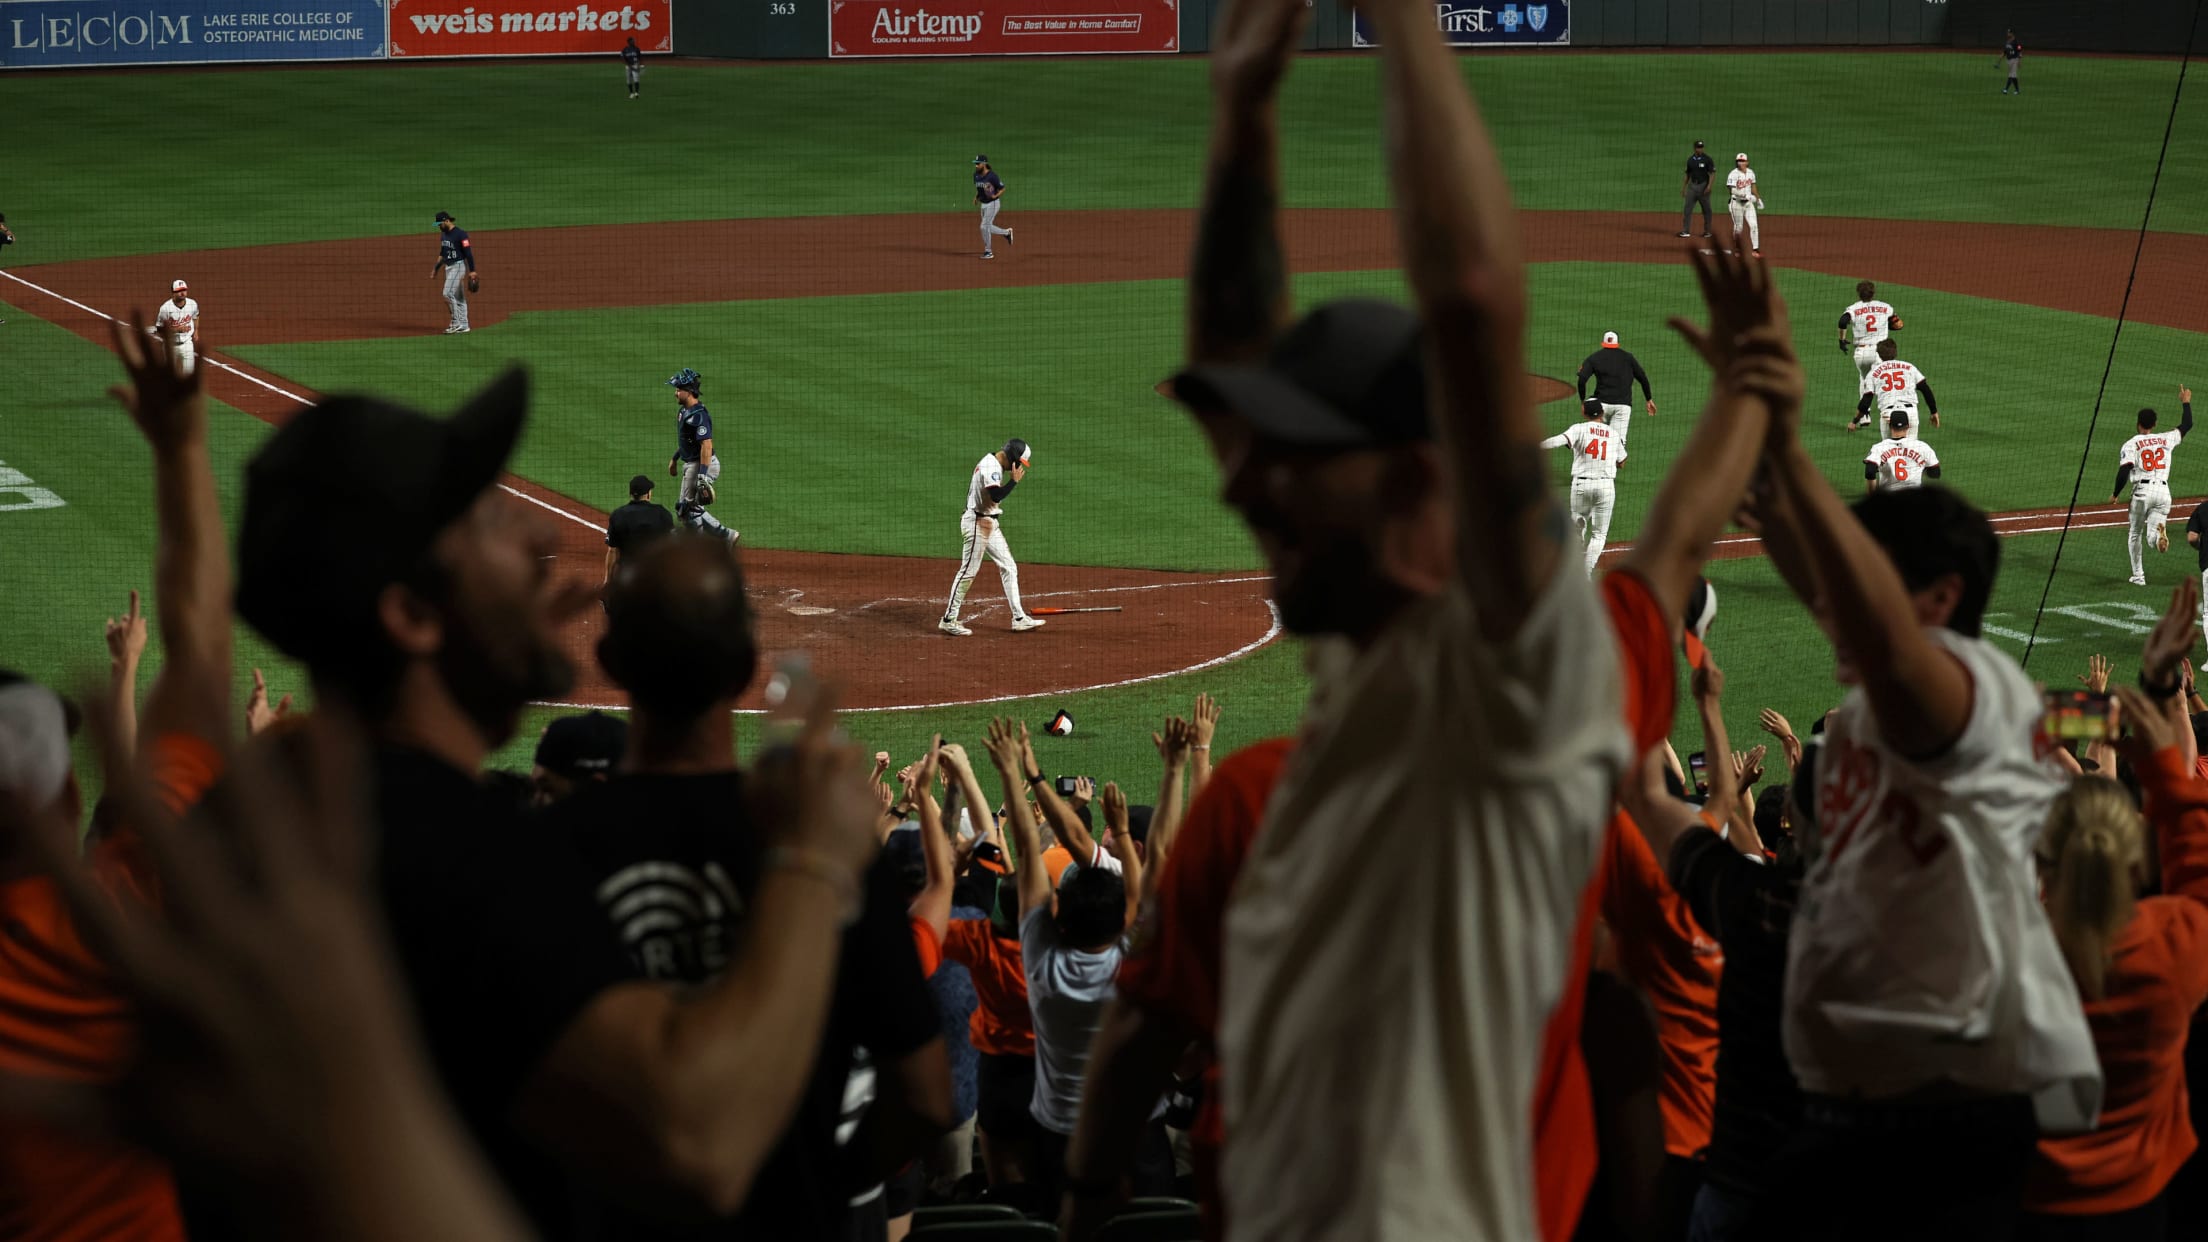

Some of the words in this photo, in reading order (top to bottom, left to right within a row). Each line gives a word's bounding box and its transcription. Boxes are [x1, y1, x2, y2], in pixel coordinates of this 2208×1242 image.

[769, 2, 796, 15] 363
[203, 14, 237, 27] LAKE
[241, 13, 269, 26] ERIE
[273, 12, 332, 26] COLLEGE
[335, 12, 354, 25] OF
[409, 7, 494, 34] weis
[499, 4, 651, 33] markets
[871, 7, 982, 42] Airtemp
[1007, 20, 1022, 30] The
[1024, 20, 1043, 30] Best
[1045, 20, 1066, 30] Value
[1078, 19, 1103, 29] Home
[1104, 18, 1138, 28] Comfort
[203, 29, 295, 43] OSTEOPATHIC
[299, 28, 364, 41] MEDICINE
[1866, 314, 1877, 332] 2
[1879, 371, 1905, 392] 35
[1585, 439, 1607, 460] 41
[2135, 438, 2167, 451] JACKSON
[2141, 448, 2166, 471] 82
[1895, 458, 1908, 481] 6
